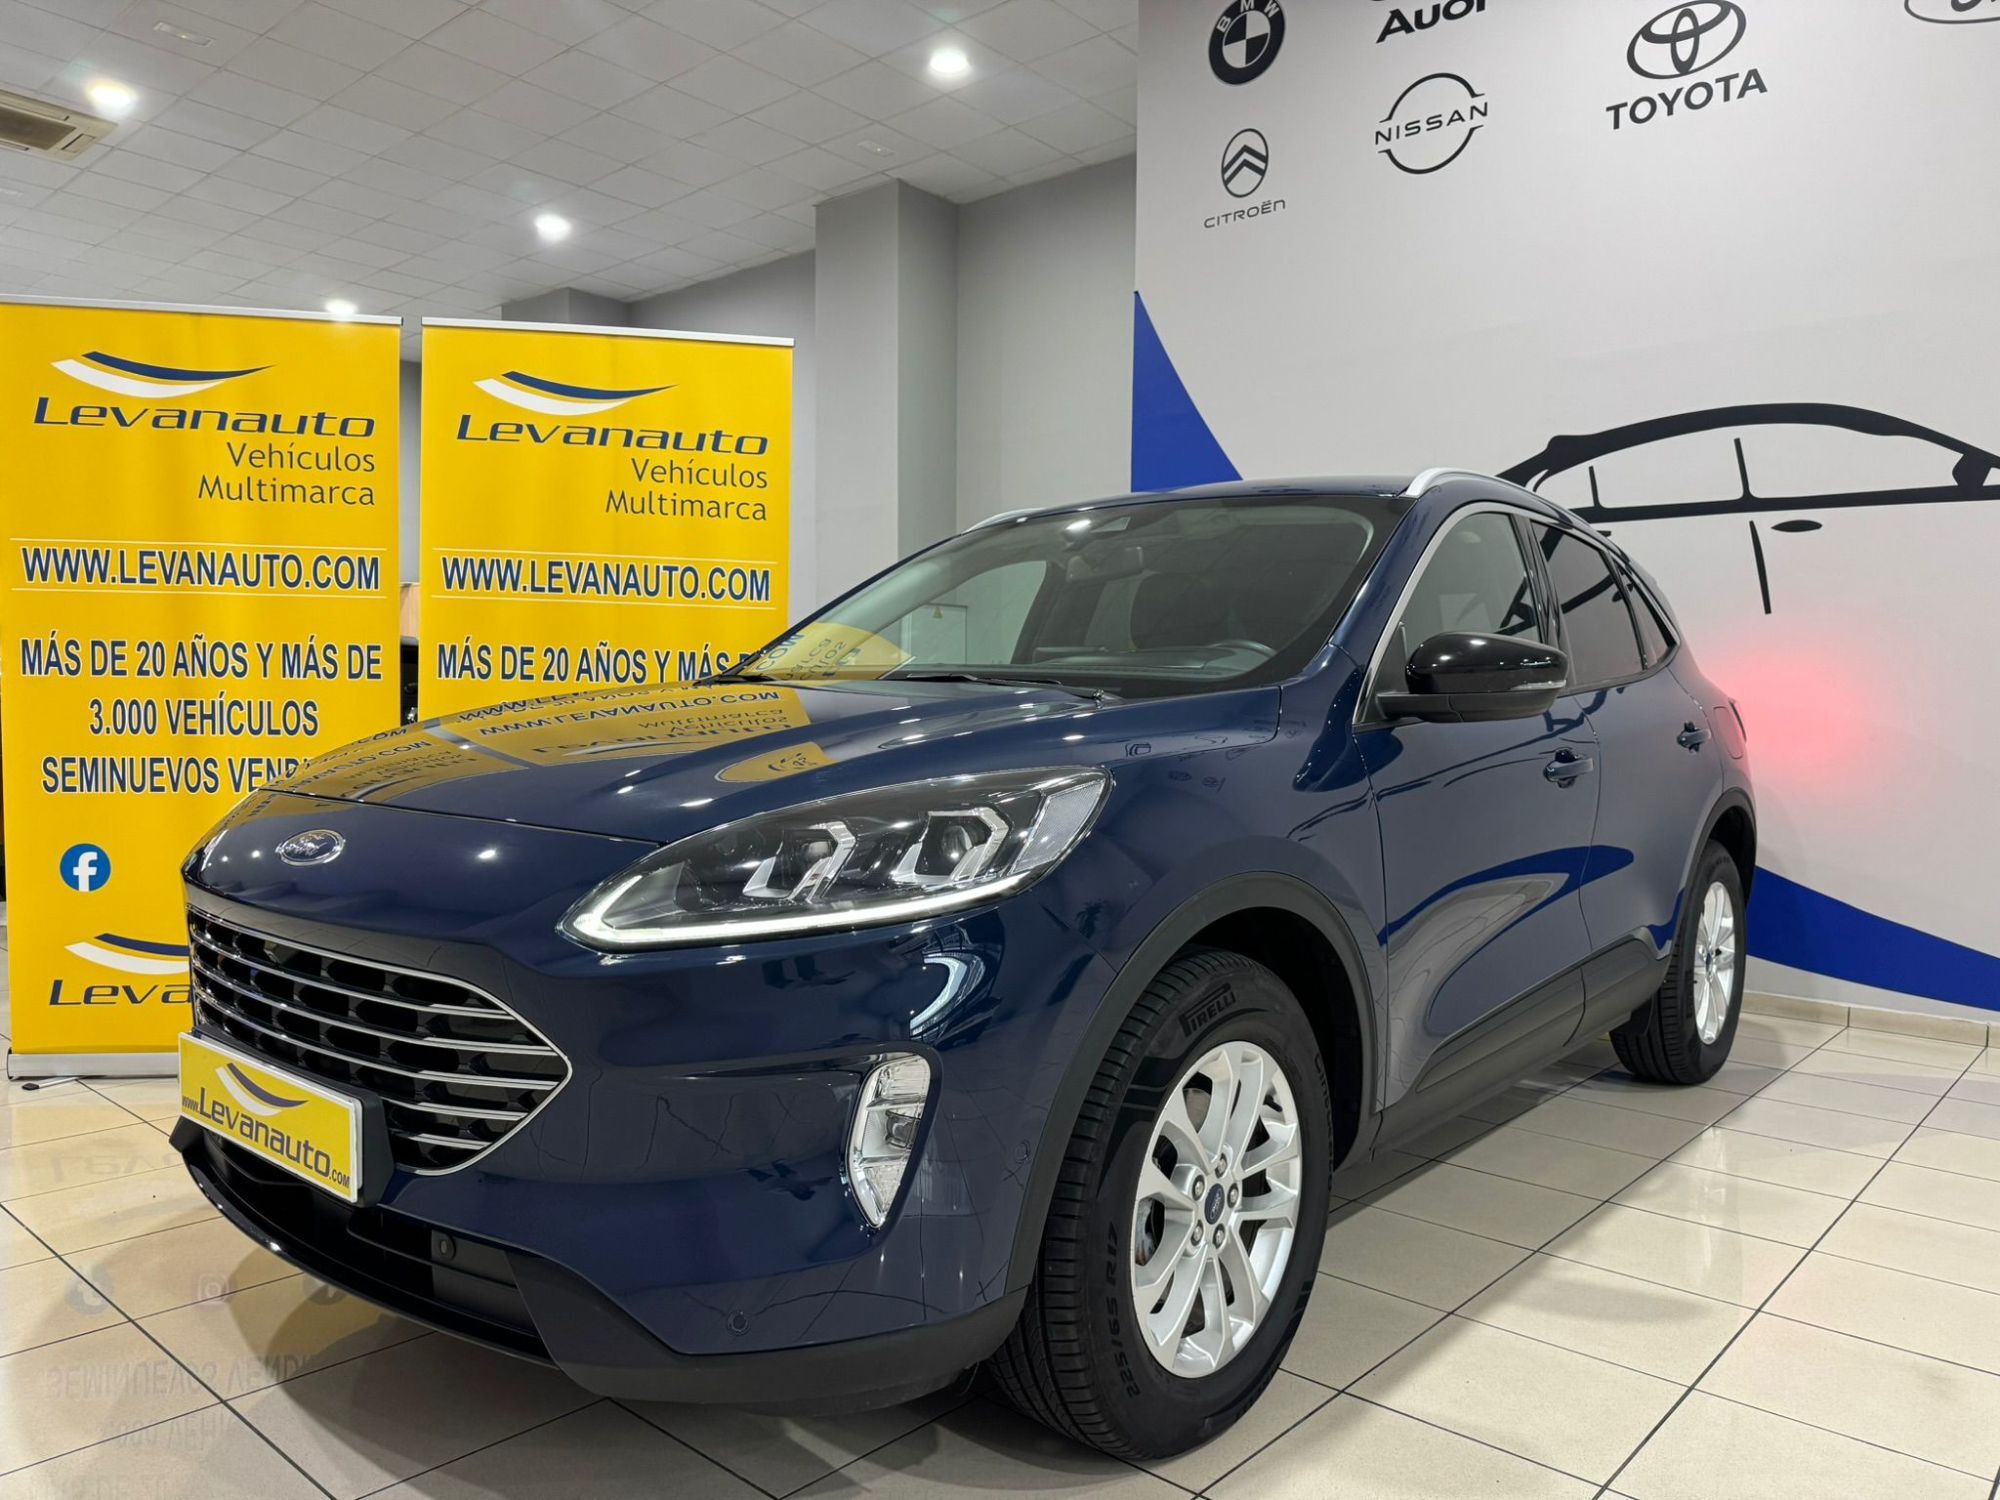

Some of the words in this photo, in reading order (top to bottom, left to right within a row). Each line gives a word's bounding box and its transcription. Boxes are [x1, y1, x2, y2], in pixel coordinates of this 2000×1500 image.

[1216, 0, 1280, 33] BMW
[1605, 67, 1768, 130] TOYOTA
[1375, 102, 1488, 145] NISSAN
[1203, 198, 1286, 229] CITROËN
[33, 396, 375, 438] Levanauto
[456, 414, 768, 455] Levanauto
[226, 441, 375, 473] Vehículos
[630, 457, 768, 489] Vehículos
[197, 474, 376, 506] Multimarca
[605, 489, 767, 521] Multimarca
[21, 547, 379, 590] WWW.LEVANAUTO.COM
[442, 557, 770, 601] WWW.LEVANAUTO.COM
[21, 630, 81, 676] MÁS
[90, 640, 127, 676] DE
[136, 640, 165, 677] 20
[172, 633, 248, 678] AÑOS
[256, 643, 274, 678] Y
[282, 634, 338, 680] MÁS
[348, 644, 382, 680] DE
[438, 637, 492, 680] MÁS
[501, 646, 535, 681] DE
[542, 647, 569, 682] 20
[575, 641, 647, 683] AÑOS
[654, 650, 671, 684] Y
[678, 643, 730, 681] MÁS
[89, 698, 157, 735] 3.000
[165, 691, 318, 736] VEHÍCULOS
[42, 756, 219, 794] SEMINUEVOS
[1178, 983, 1237, 1038] PIRELLI
[1105, 1221, 1118, 1286] R17
[1106, 1296, 1141, 1398] 225/65
